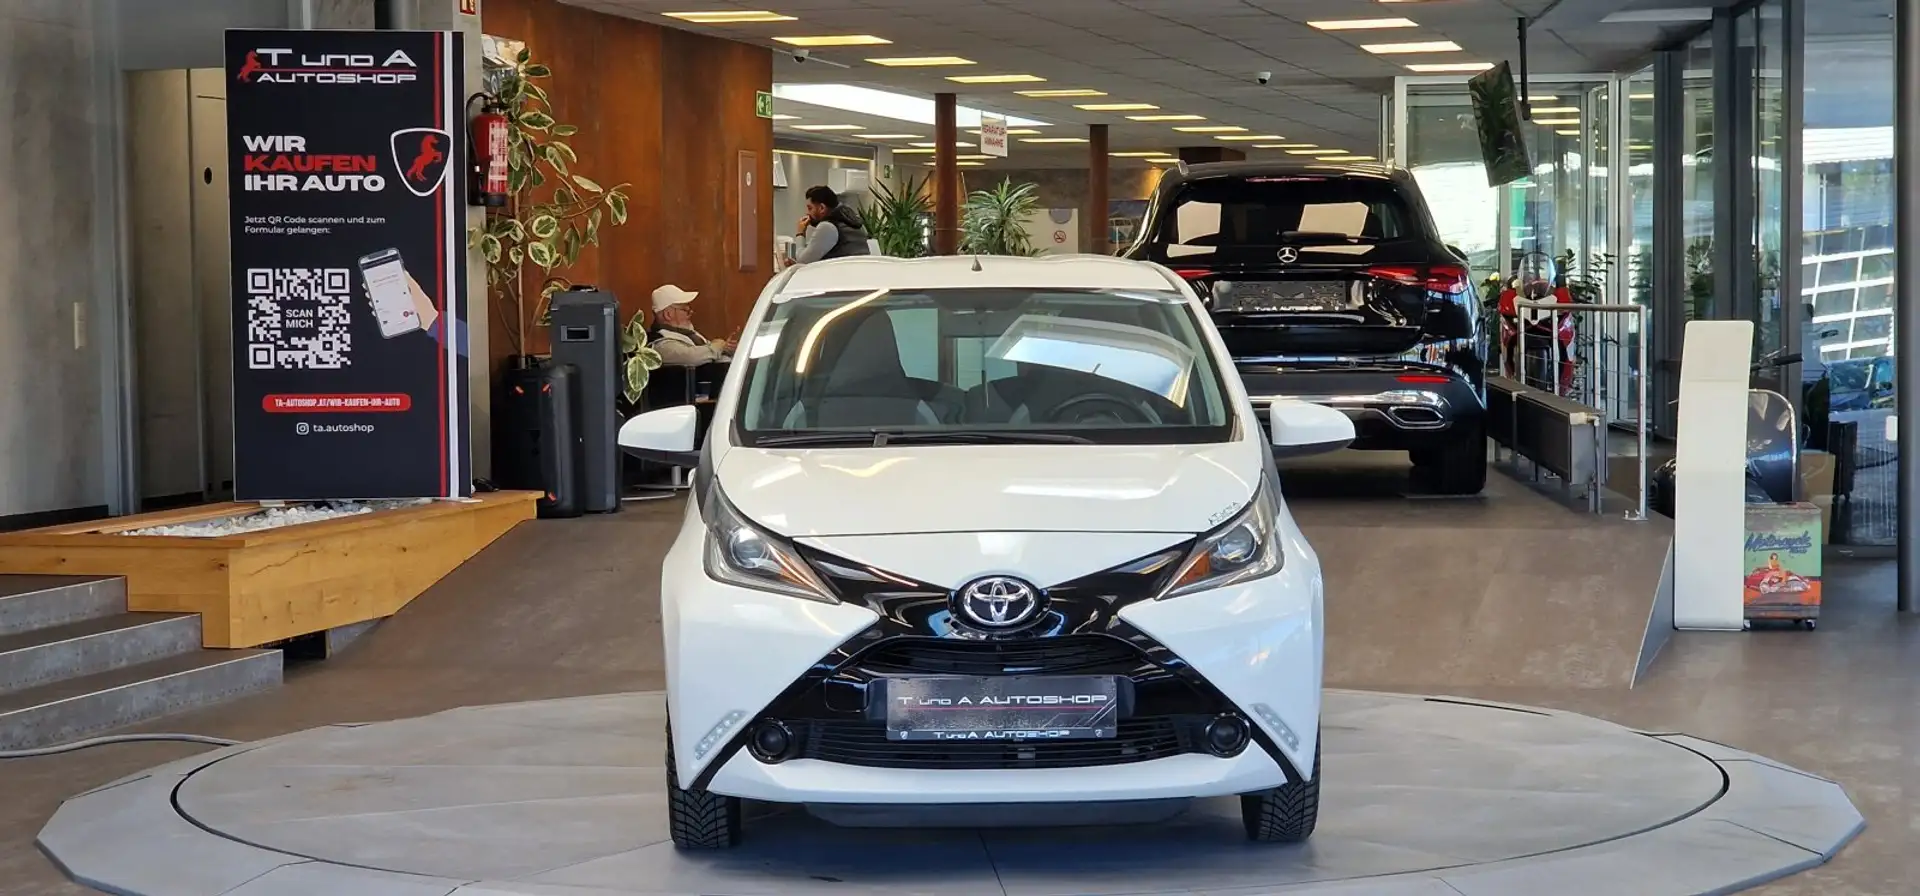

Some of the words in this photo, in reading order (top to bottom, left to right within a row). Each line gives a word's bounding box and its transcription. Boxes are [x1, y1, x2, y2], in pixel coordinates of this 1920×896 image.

[256, 48, 293, 66] T
[382, 49, 417, 67] A
[257, 73, 417, 84] AUTOSHOP
[243, 135, 306, 152] WIR
[244, 155, 376, 172] KAUFEN
[244, 175, 298, 191] IHR
[302, 175, 386, 191] AUTO
[244, 216, 267, 225] Jetzt
[267, 216, 282, 225] QR
[283, 216, 306, 225] Code
[346, 216, 365, 224] und
[244, 226, 285, 235] Formular
[287, 226, 331, 236] gelangen:
[285, 309, 314, 318] SCAN
[285, 319, 314, 329] MICH
[313, 423, 375, 435] ta.autoshop
[898, 697, 916, 705] T
[957, 696, 973, 705] A
[980, 695, 1108, 705] AUTOSHOP
[933, 731, 945, 739] T
[967, 730, 979, 739] A
[984, 730, 1070, 739] AUTOSHOP
